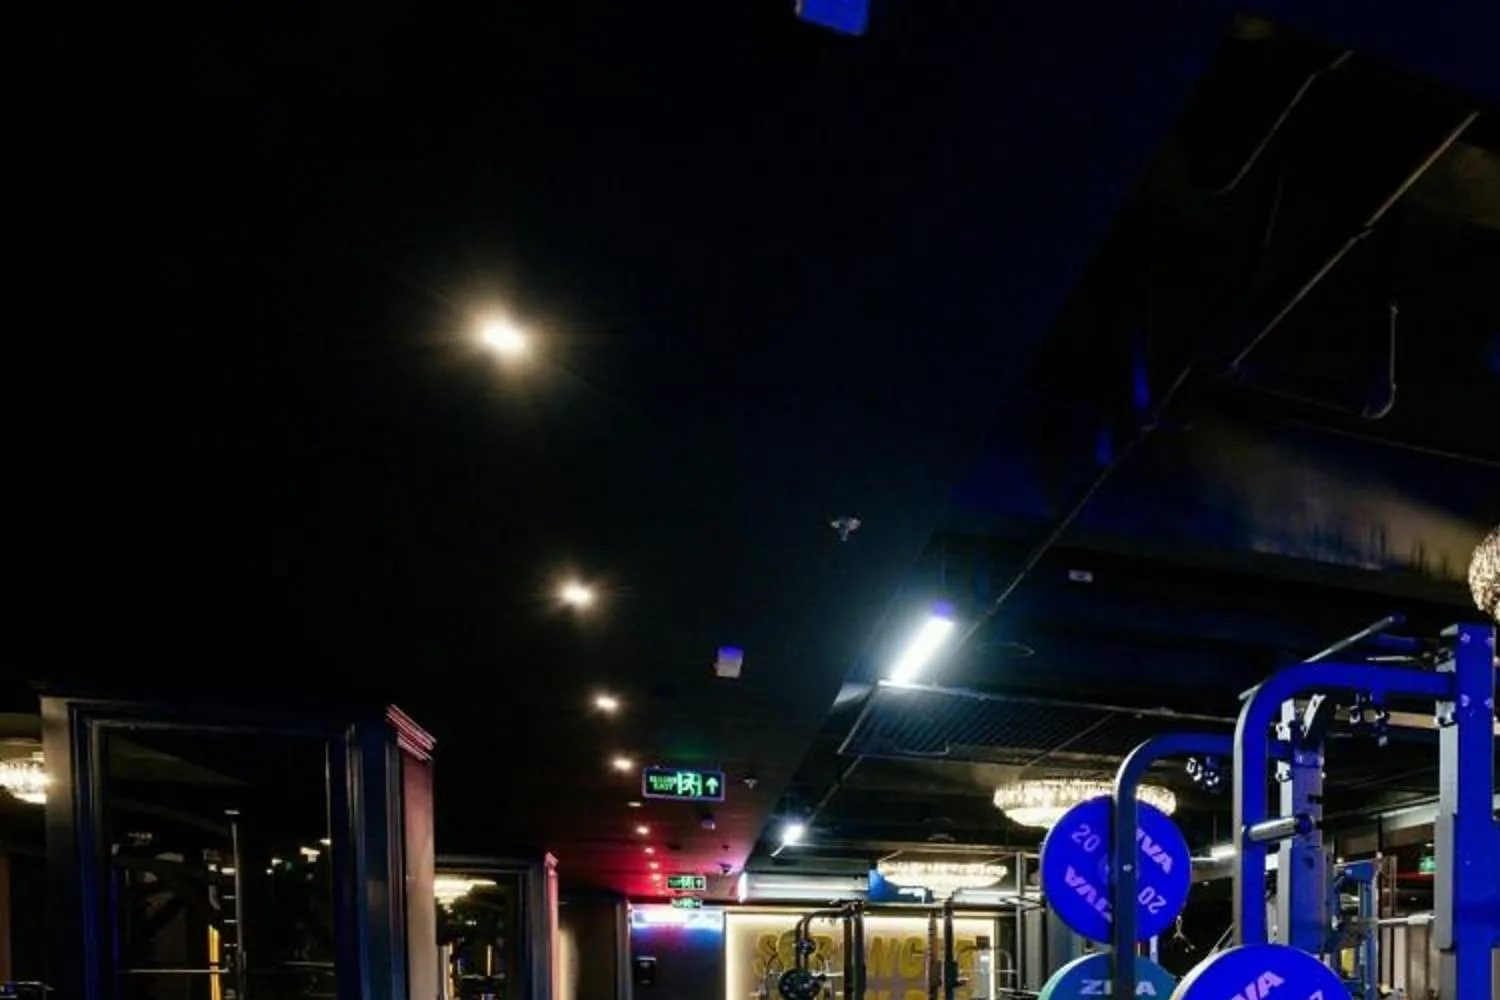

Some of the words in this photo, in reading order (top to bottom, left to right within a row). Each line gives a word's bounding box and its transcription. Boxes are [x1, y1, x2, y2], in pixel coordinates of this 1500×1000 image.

[1071, 823, 1101, 853] 20
[1135, 827, 1173, 875] IVA
[1137, 886, 1168, 915] 20
[1079, 979, 1157, 996] ZIA
